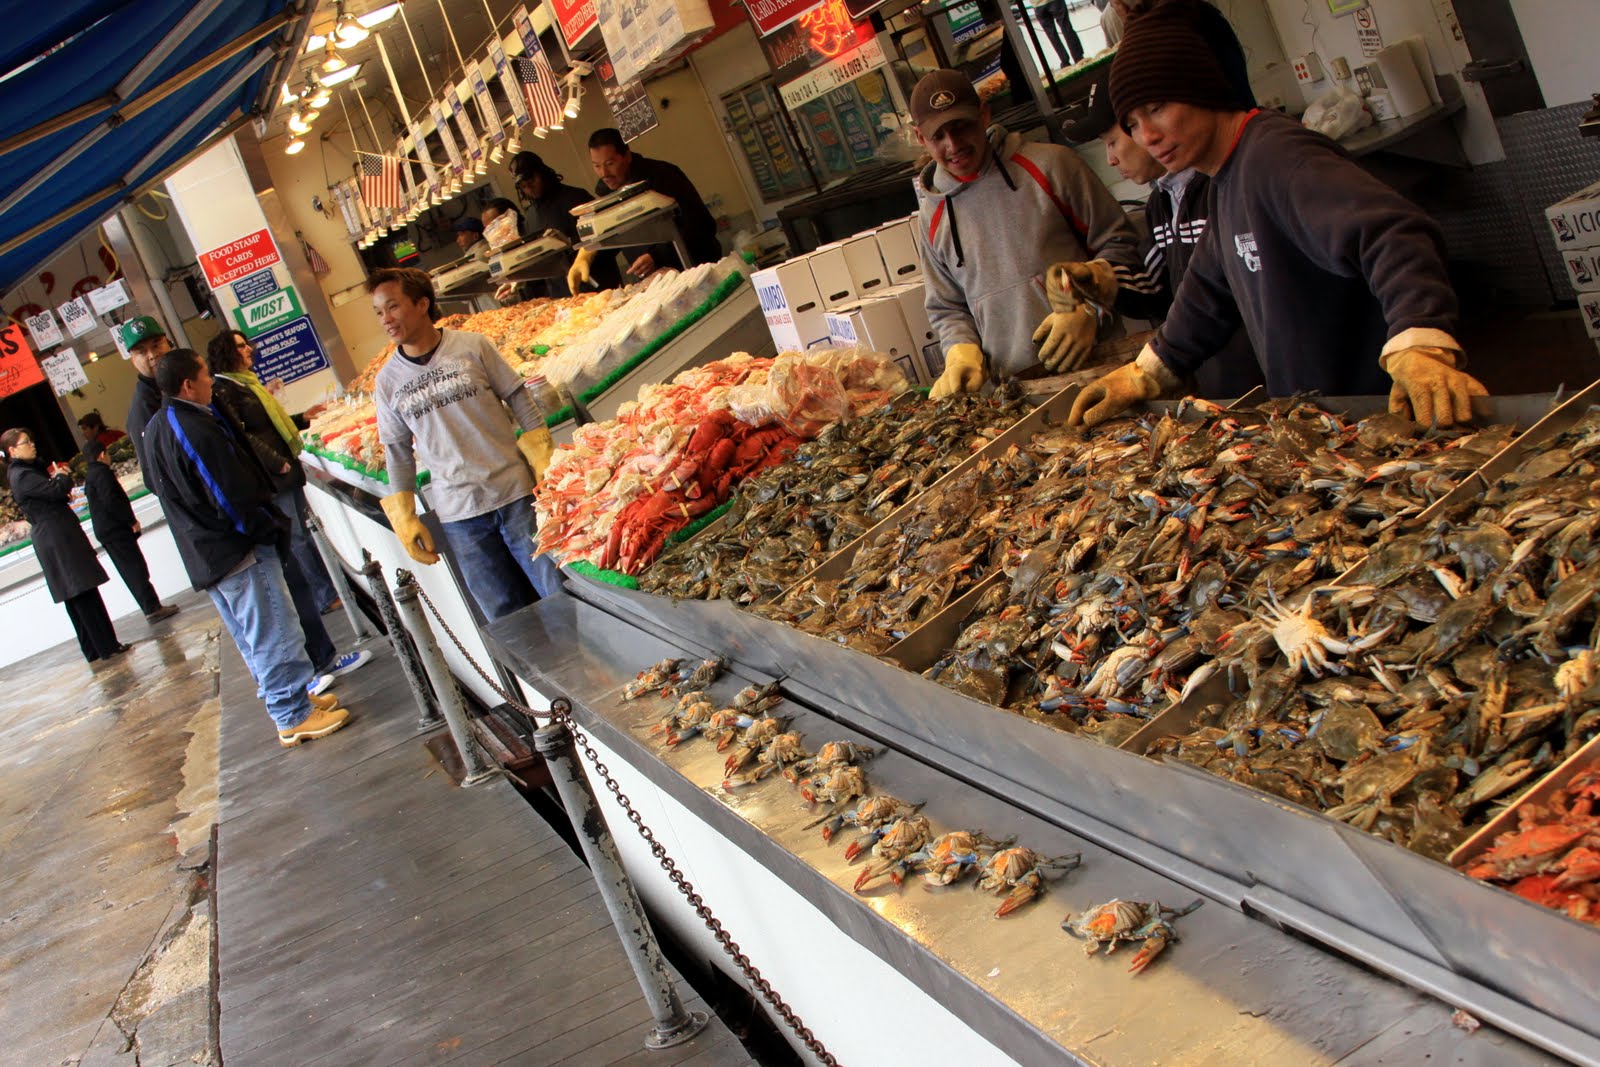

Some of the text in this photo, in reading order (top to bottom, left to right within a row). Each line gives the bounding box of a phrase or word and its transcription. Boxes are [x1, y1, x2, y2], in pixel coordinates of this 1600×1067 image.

[848, 58, 864, 77] OVER
[208, 234, 260, 262] FOOD STAMP
[226, 250, 254, 267] CARDS
[213, 252, 277, 286] ACCEPTED HERE
[64, 301, 79, 314] LARGE
[250, 296, 284, 322] MOST
[758, 284, 786, 312] JUMBO
[30, 314, 50, 327] CLEANED
[65, 308, 87, 322] OCTOPUS
[264, 332, 284, 346] WHITE'S
[284, 322, 308, 336] SEAFOOD
[260, 336, 298, 356] REFUND POLICY
[279, 350, 295, 360] Refund
[262, 364, 284, 375] Exchange
[290, 354, 304, 363] Credit
[277, 368, 292, 376] Return
[292, 356, 320, 370] Merchandise
[395, 360, 466, 398] DKNY JEANS 1989
[407, 371, 459, 396] DKNY JEANS
[430, 373, 472, 398] JEANS
[413, 404, 433, 419] DKNY
[436, 387, 478, 409] JEANS/NY
